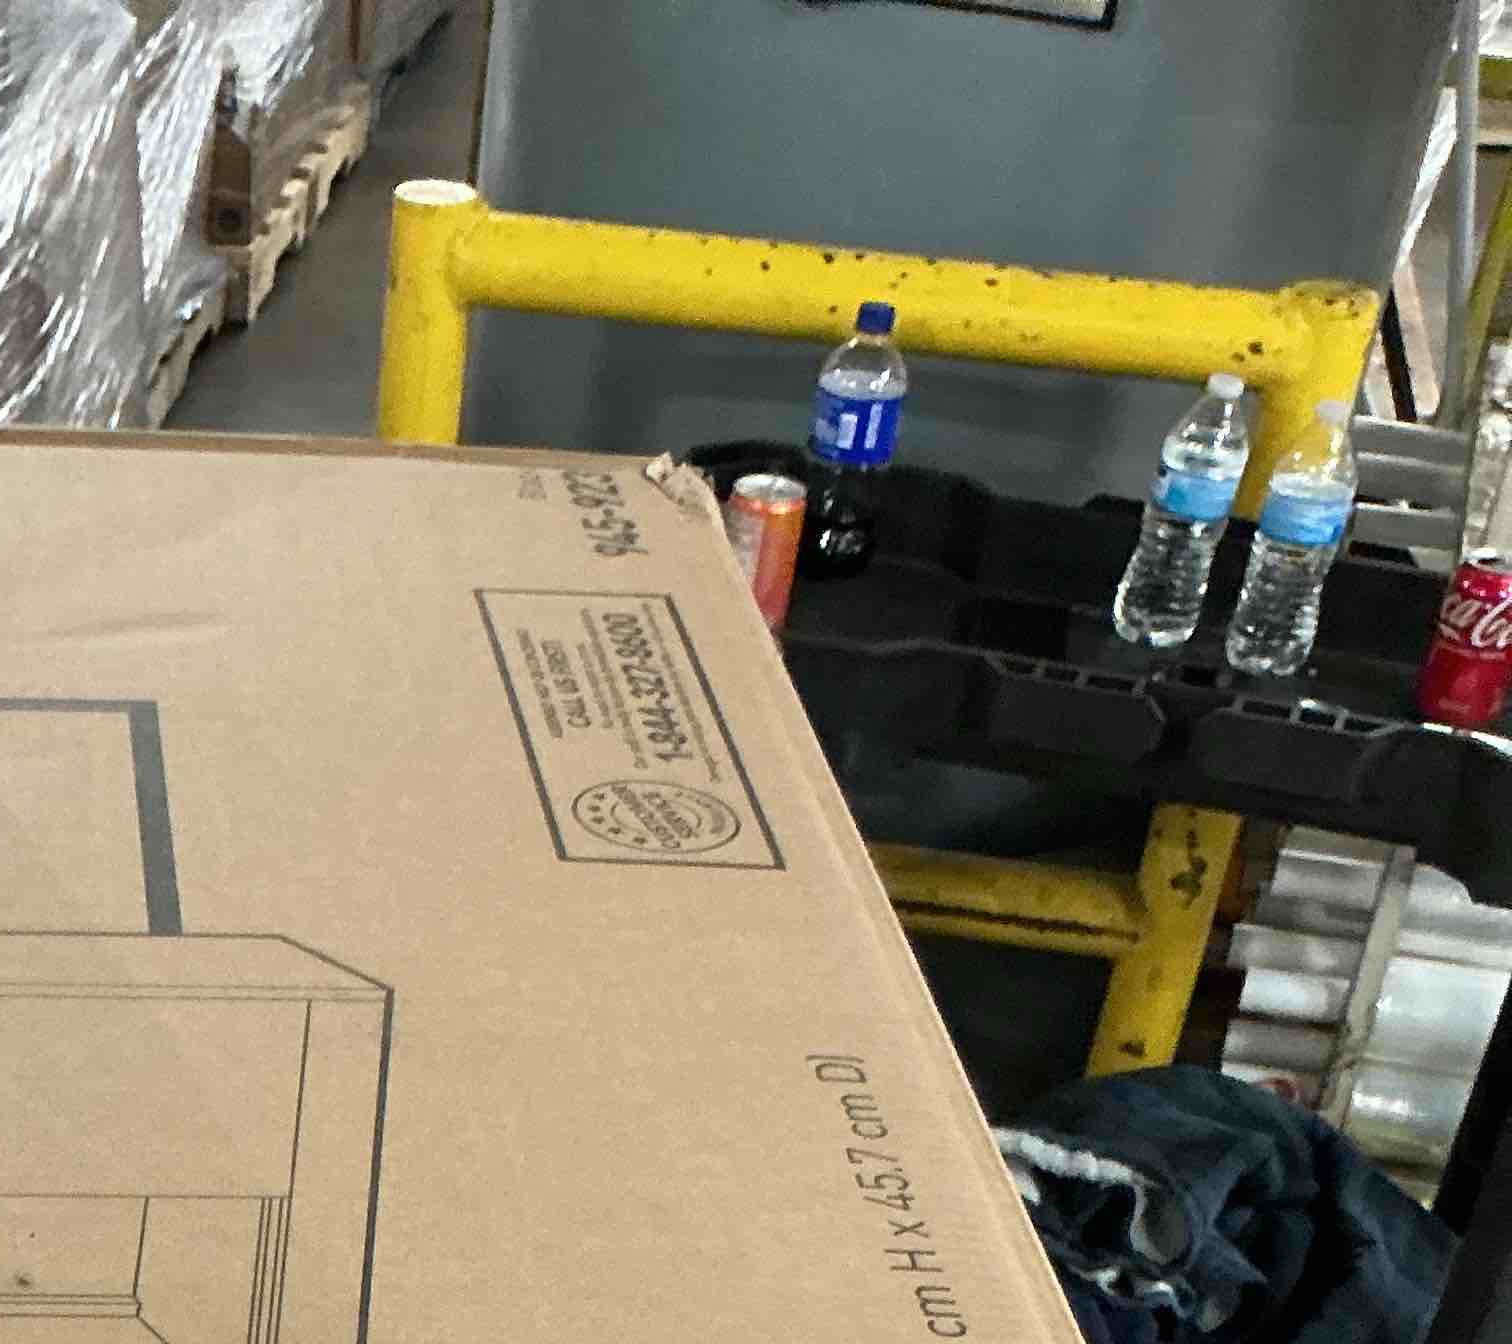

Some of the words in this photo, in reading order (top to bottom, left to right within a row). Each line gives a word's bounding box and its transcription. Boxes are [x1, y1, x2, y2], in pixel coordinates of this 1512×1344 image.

[841, 1093, 888, 1140] cm
[845, 1146, 915, 1212] 45.7
[892, 1220, 931, 1239] x
[884, 1248, 944, 1273] H
[915, 1284, 968, 1339] cm
